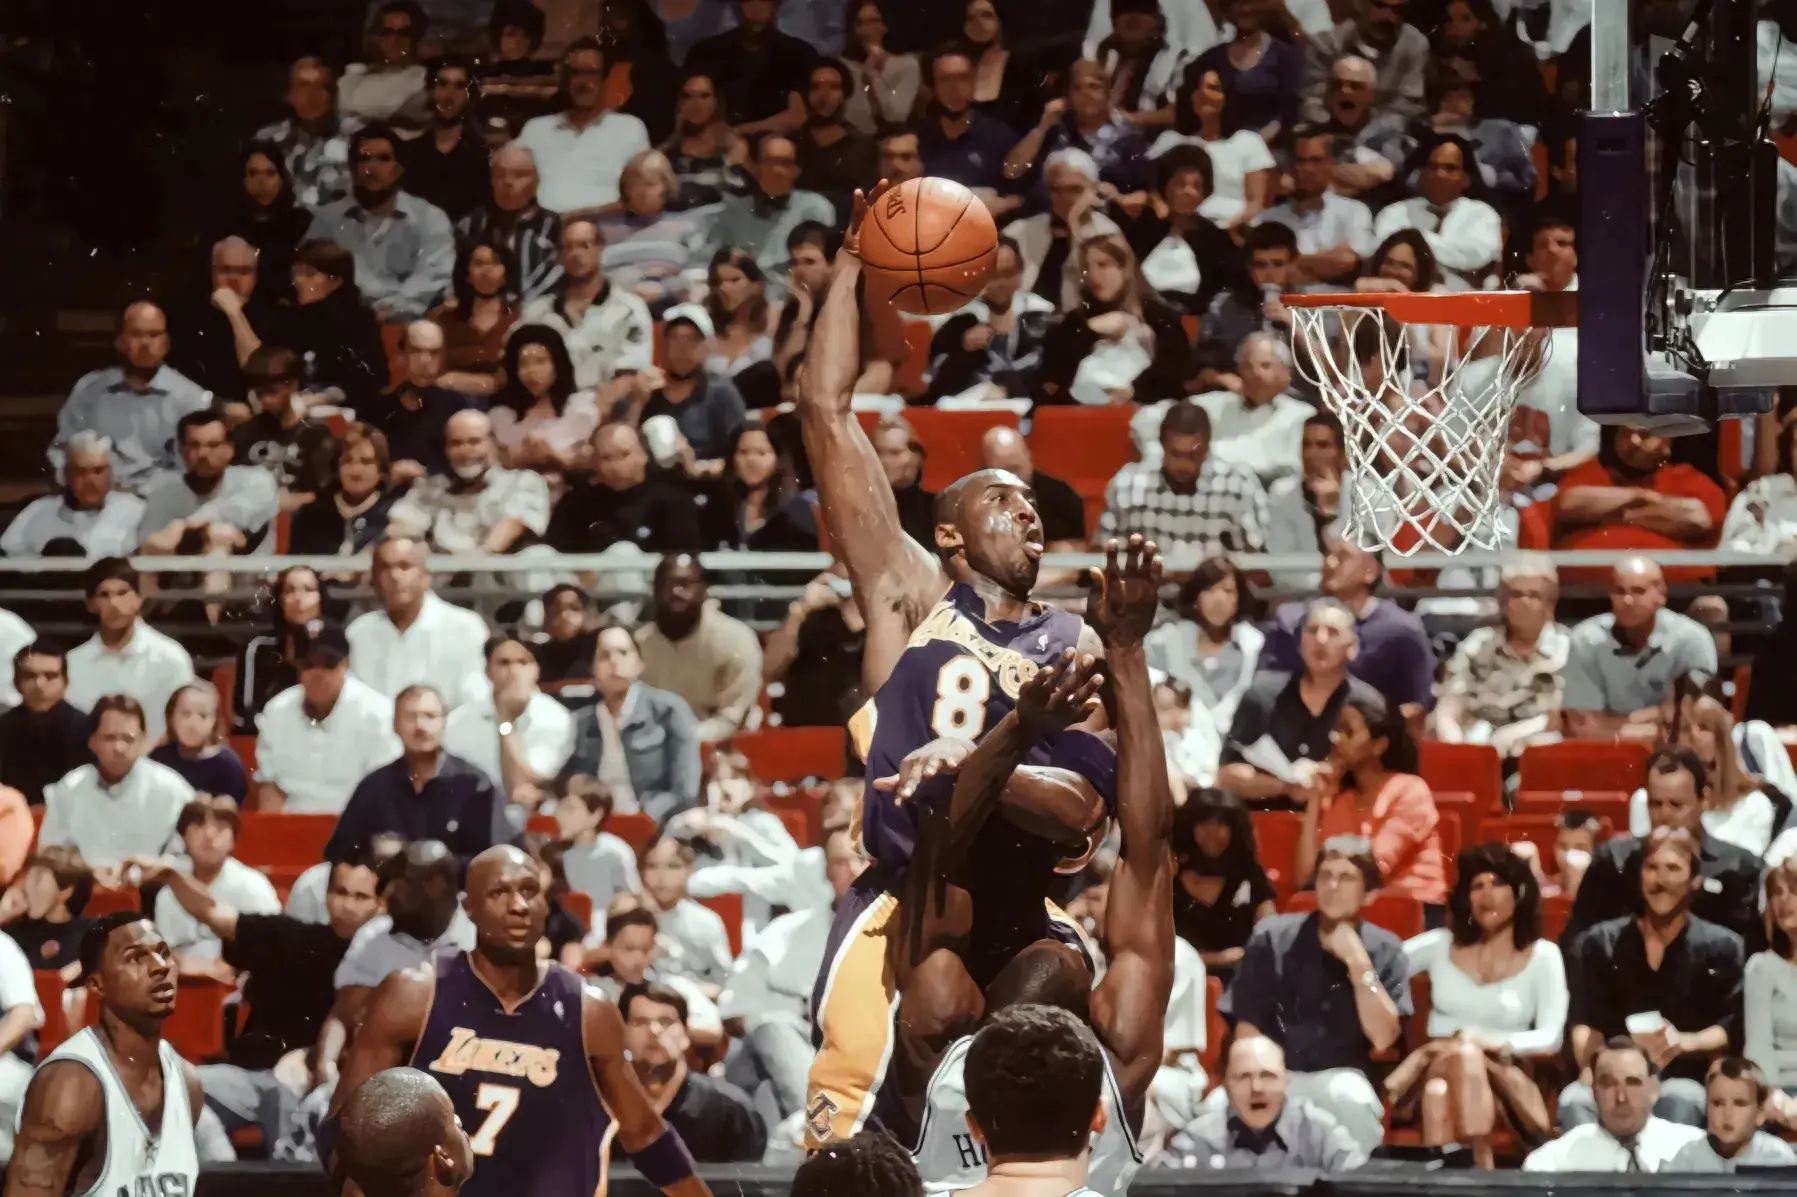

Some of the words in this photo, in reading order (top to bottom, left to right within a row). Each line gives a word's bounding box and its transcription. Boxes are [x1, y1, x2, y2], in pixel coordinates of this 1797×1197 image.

[932, 653, 990, 740] 8
[429, 1026, 560, 1087] LAKERS
[470, 1082, 521, 1156] 7
